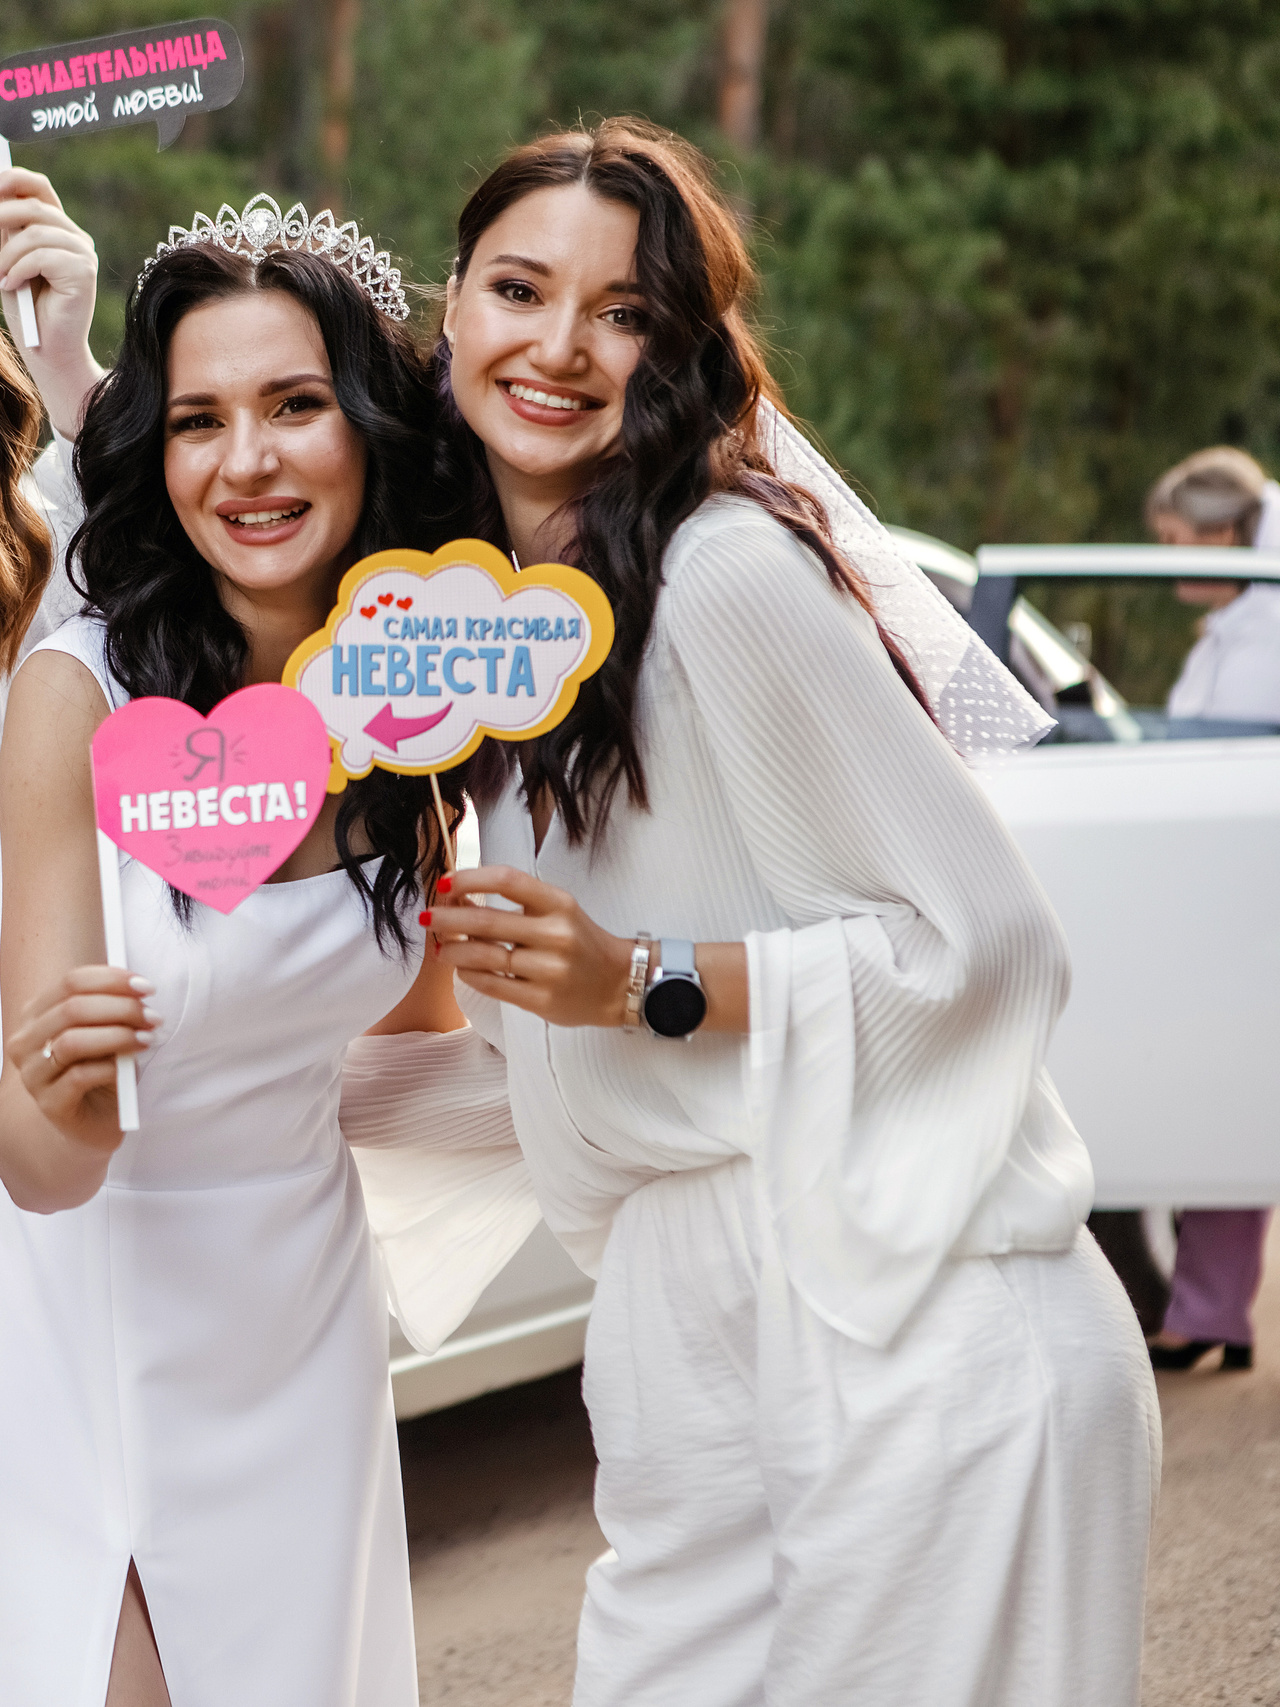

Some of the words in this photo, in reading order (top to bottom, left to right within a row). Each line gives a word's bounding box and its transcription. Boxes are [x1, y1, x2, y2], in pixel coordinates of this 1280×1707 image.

[383, 617, 458, 641] САМАЯ
[465, 617, 581, 642] КРАСИВАЯ
[331, 644, 537, 698] НЕВЕСТА
[182, 726, 226, 783] Я
[119, 780, 308, 834] НЕВЕСТА!
